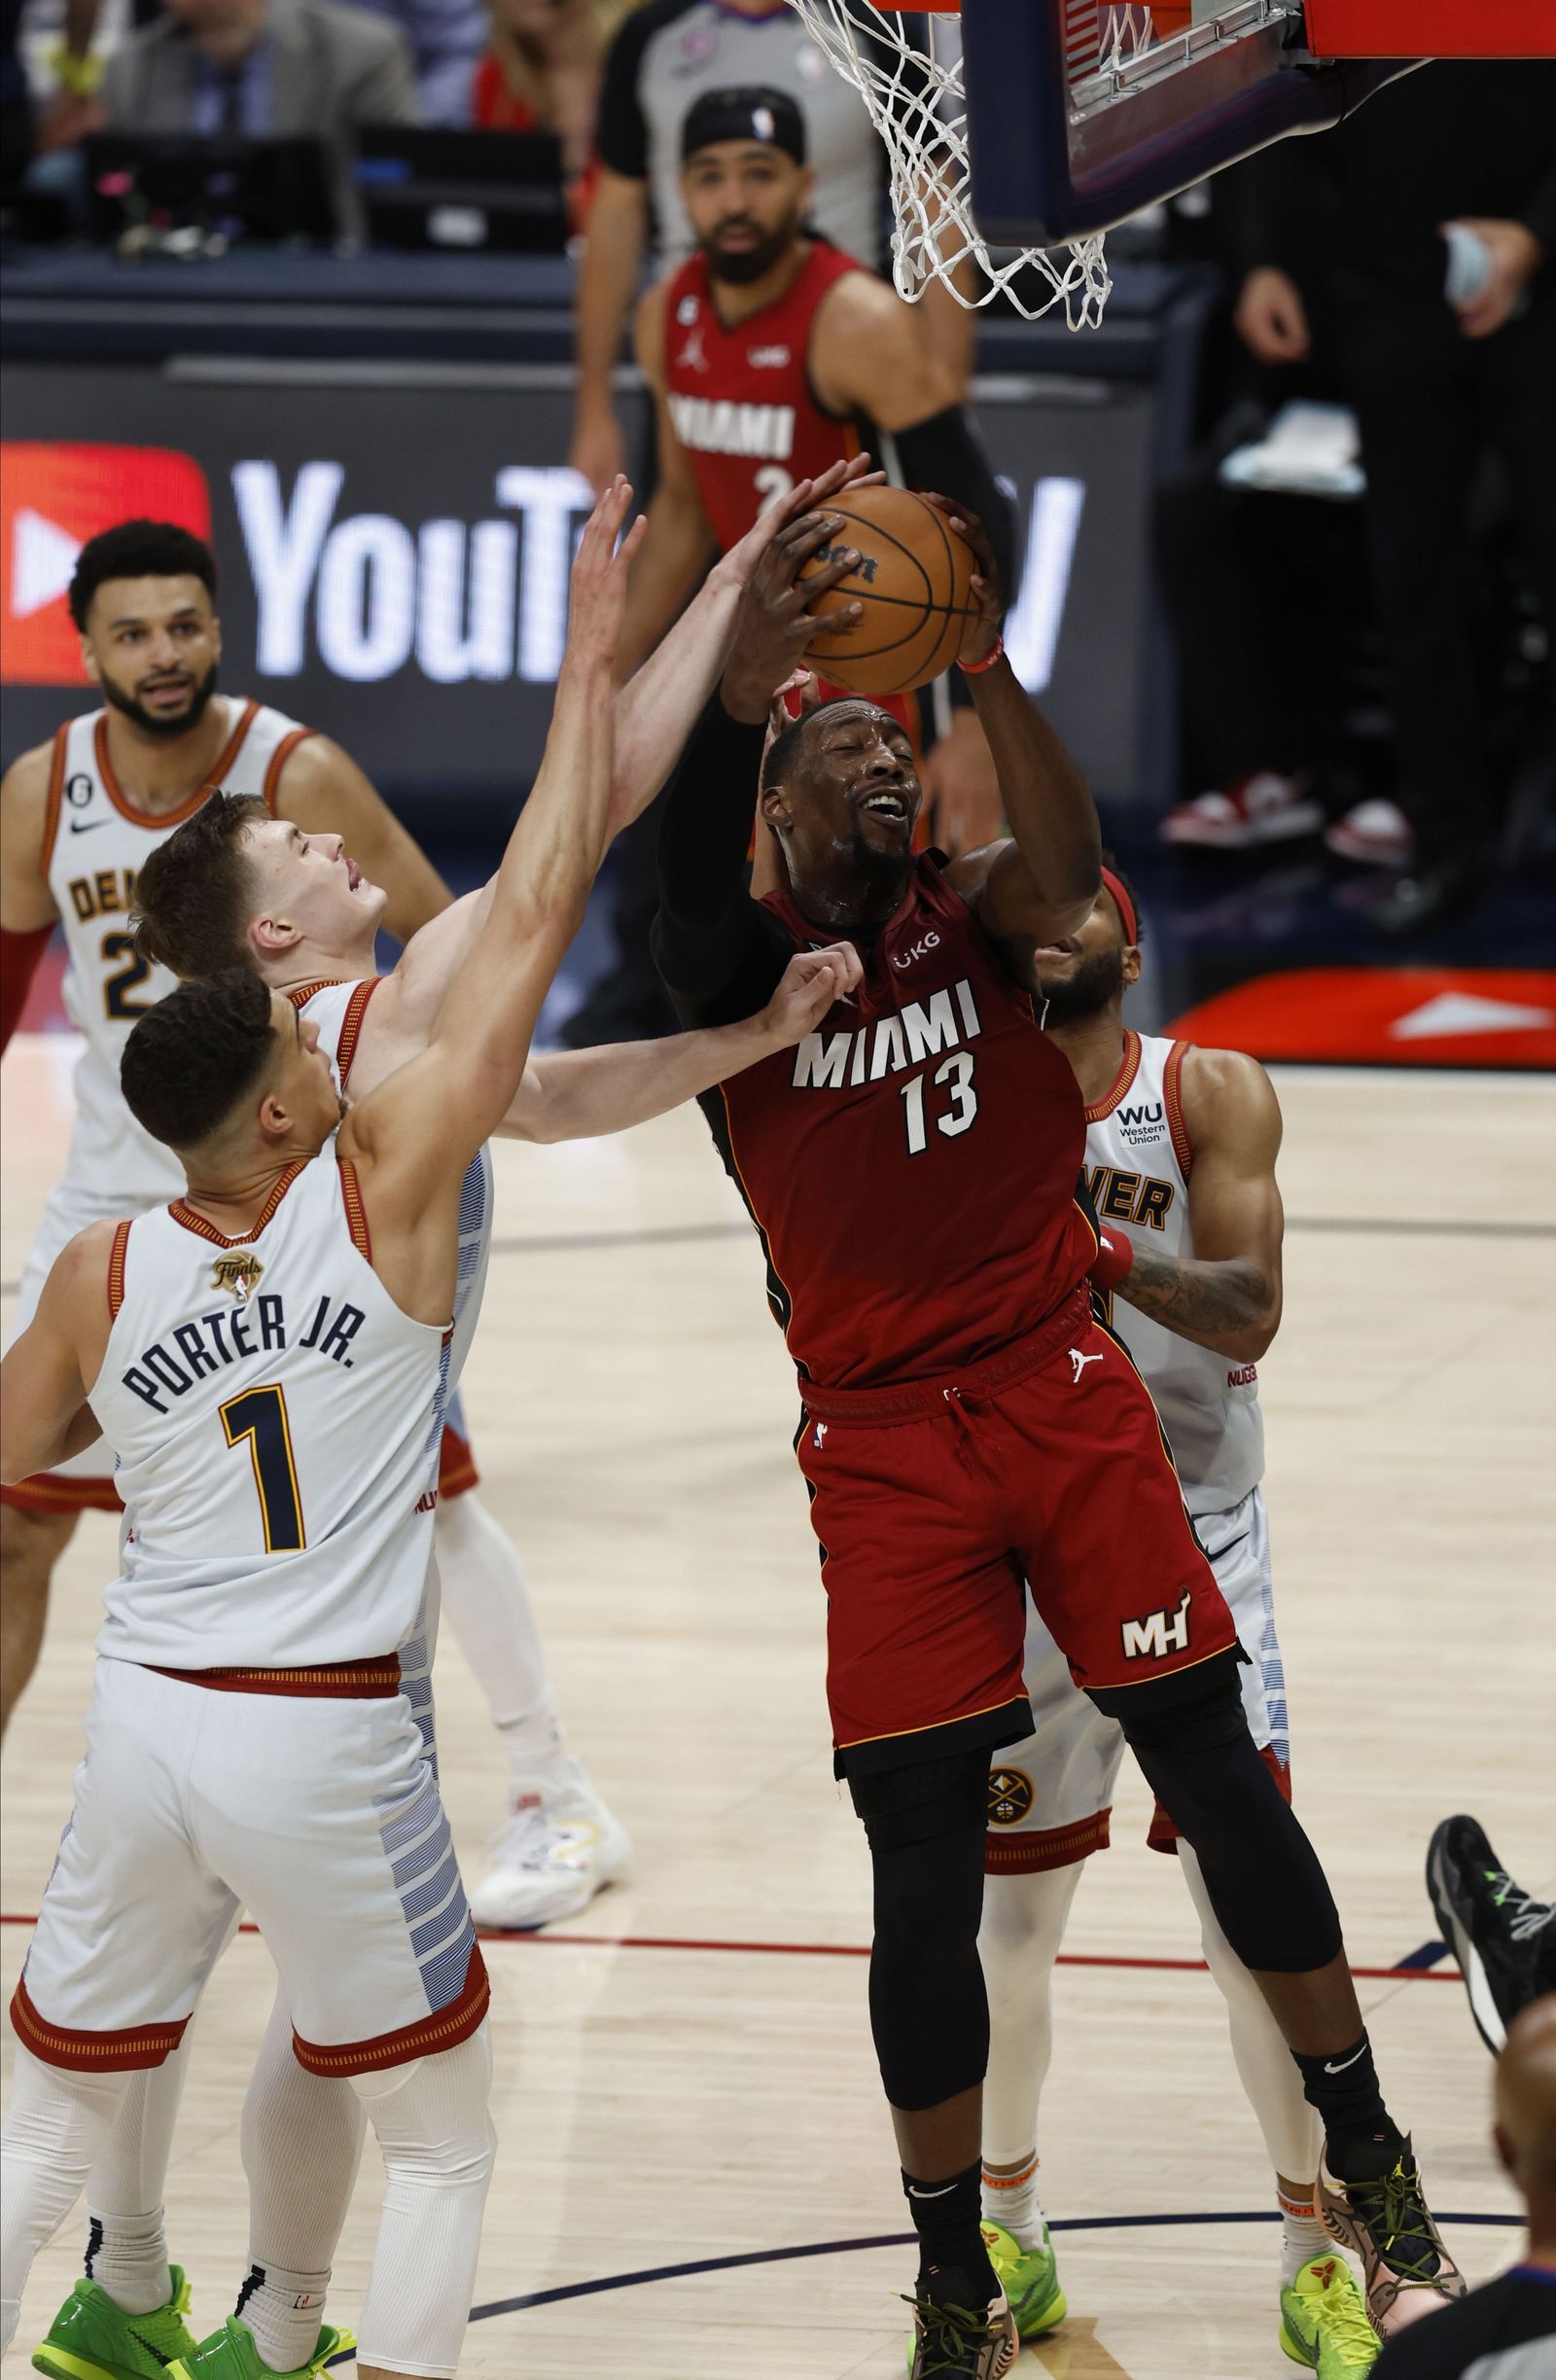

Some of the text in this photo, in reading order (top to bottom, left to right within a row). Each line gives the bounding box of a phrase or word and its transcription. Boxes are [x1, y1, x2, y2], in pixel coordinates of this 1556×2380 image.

[667, 392, 796, 461] MIAMI
[230, 459, 595, 683] YouT
[101, 932, 156, 1019] 2
[791, 977, 982, 1089] MIAMI
[900, 1050, 979, 1156] 13
[1116, 1103, 1163, 1126] WU
[1119, 1124, 1166, 1137] Western
[1128, 1134, 1160, 1146] Union
[1081, 1164, 1175, 1231] VER
[210, 1257, 264, 1288] Finals
[122, 1295, 367, 1415] PORTER JR.
[1227, 1364, 1258, 1388] NUGG
[218, 1383, 307, 1555] 1
